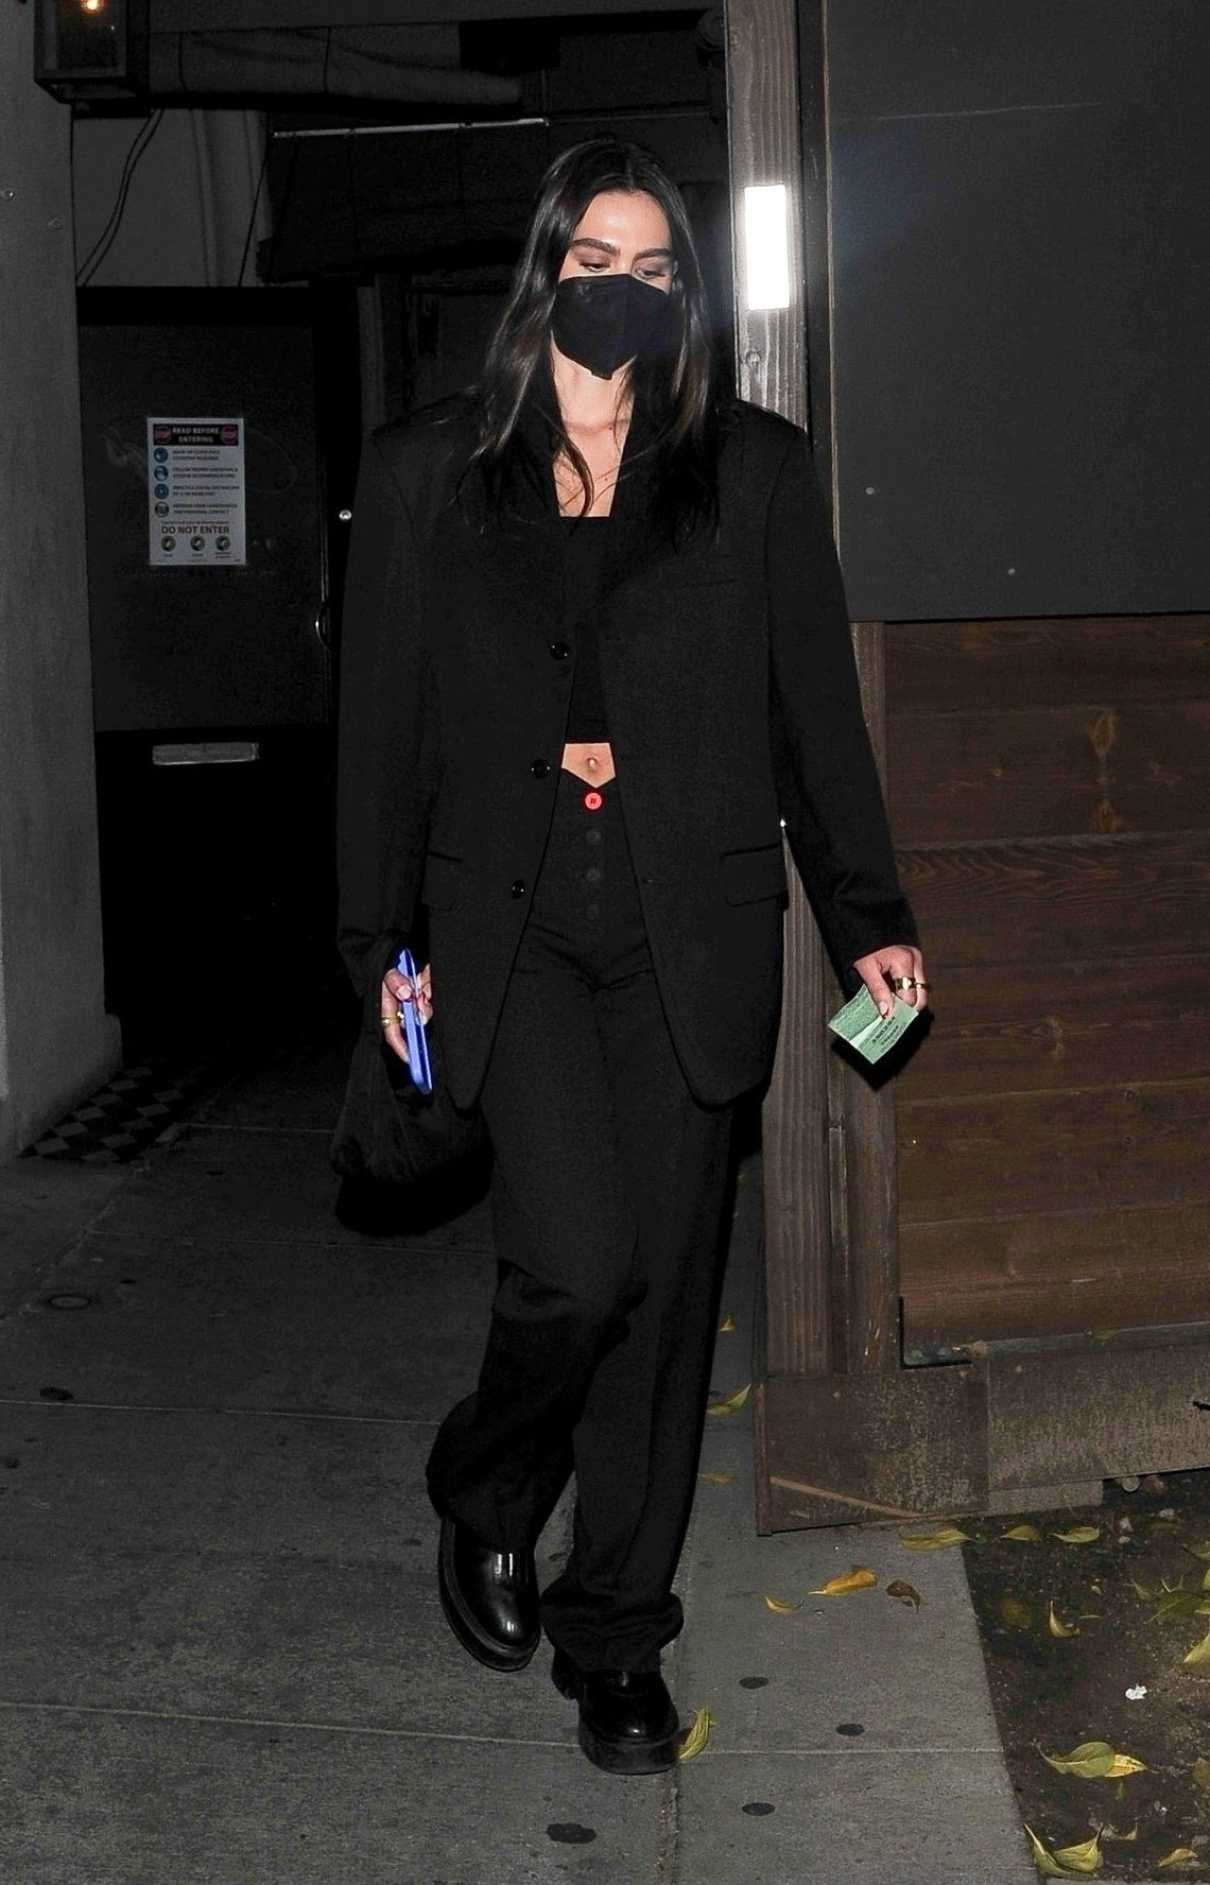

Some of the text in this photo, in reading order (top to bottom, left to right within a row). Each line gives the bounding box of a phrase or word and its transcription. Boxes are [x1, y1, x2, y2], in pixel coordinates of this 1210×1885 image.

[161, 526, 230, 534] DO NOT ENTER
